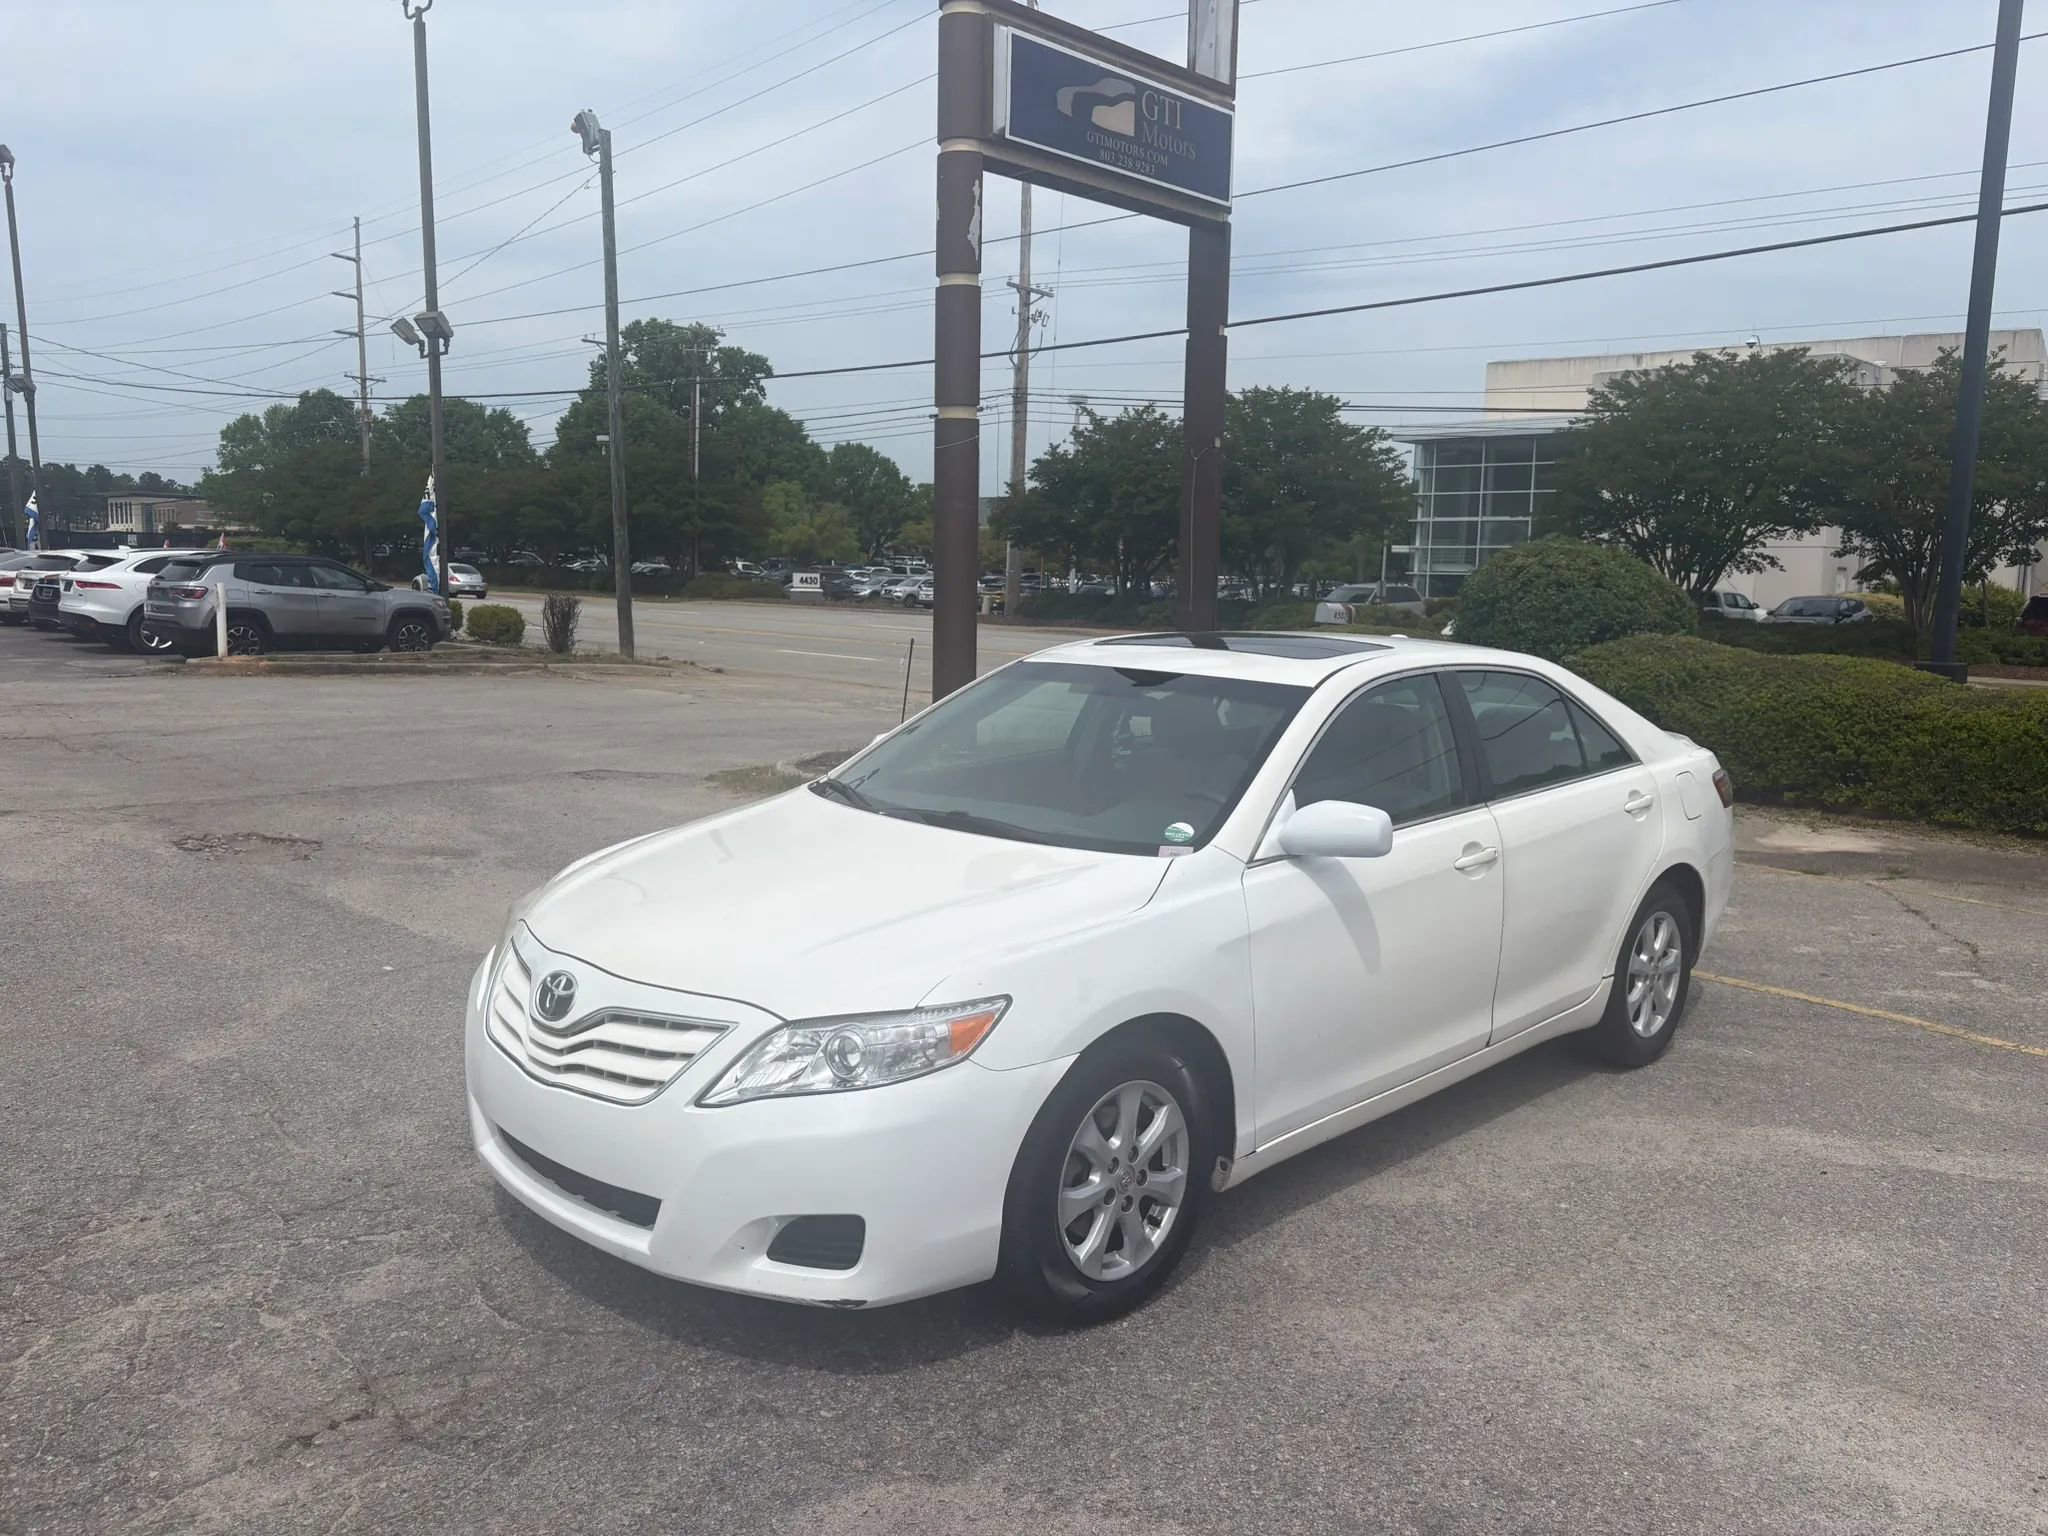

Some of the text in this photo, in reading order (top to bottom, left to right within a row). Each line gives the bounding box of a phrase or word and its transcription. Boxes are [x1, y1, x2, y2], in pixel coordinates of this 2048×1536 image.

[1142, 91, 1183, 129] GTI
[1087, 130, 1169, 166] GTIMOTORS.COM
[1142, 121, 1197, 160] Motors
[799, 576, 819, 585] 4430
